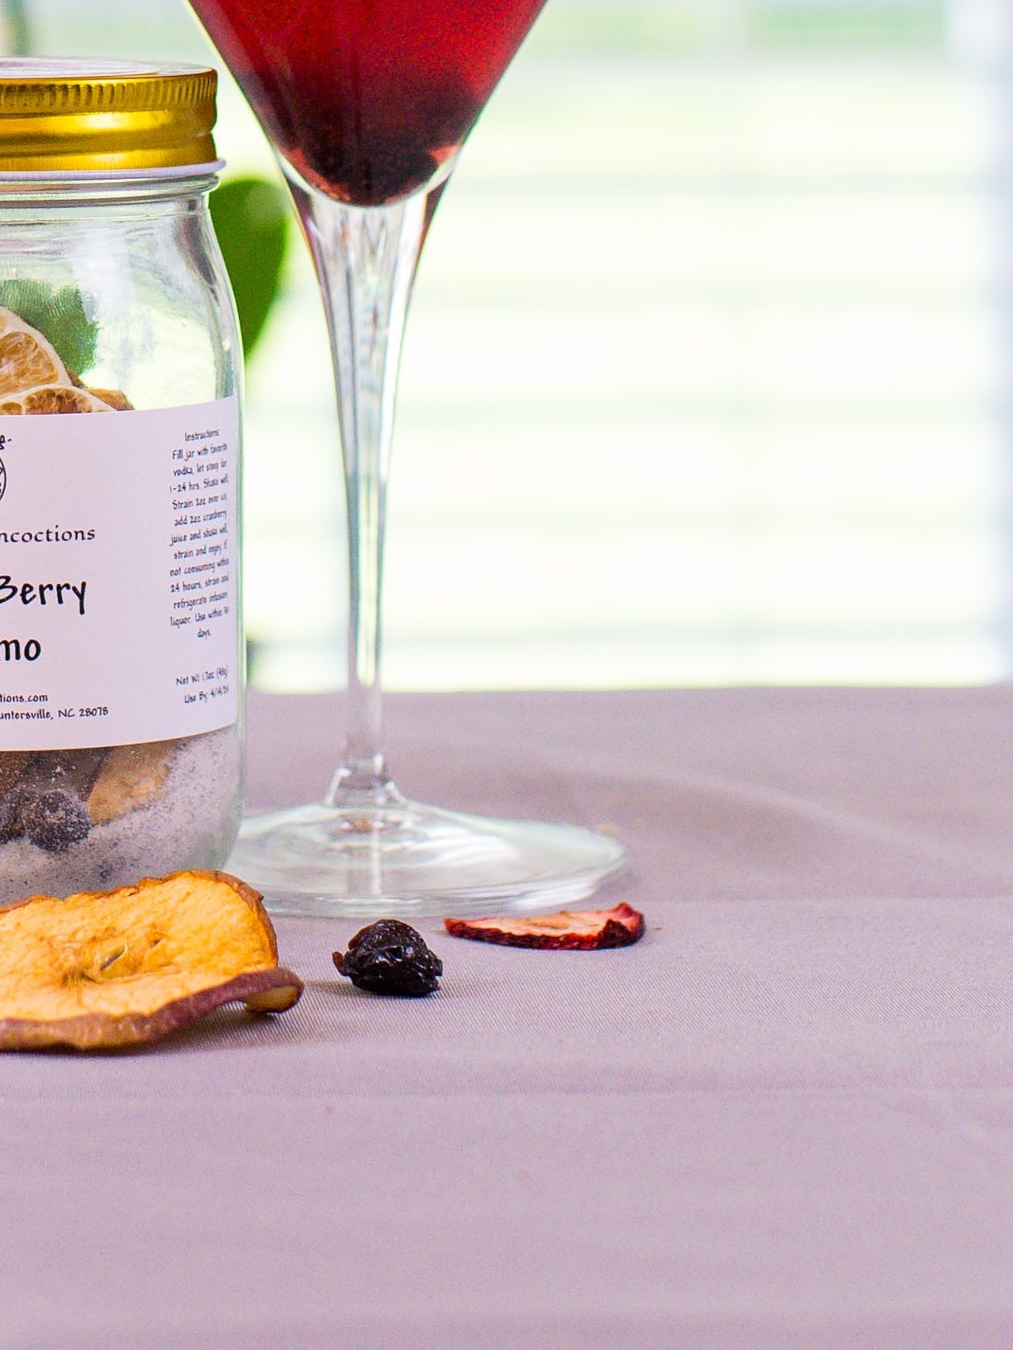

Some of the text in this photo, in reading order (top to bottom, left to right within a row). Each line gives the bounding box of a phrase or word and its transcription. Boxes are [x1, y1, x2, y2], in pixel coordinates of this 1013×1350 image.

[172, 449, 183, 460] Fill
[185, 450, 195, 461] jar
[196, 463, 204, 473] let
[172, 499, 194, 510] Strain
[174, 515, 187, 526] add
[190, 515, 201, 524] 2oz
[169, 534, 187, 547] juice
[190, 529, 201, 541] and
[174, 550, 194, 560] strain
[196, 545, 207, 556] and
[170, 566, 181, 577] not
[170, 582, 180, 593] 24
[195, 613, 206, 622] Use
[176, 676, 189, 685] Net
[185, 694, 196, 704] Use
[58, 709, 75, 719] NC
[79, 706, 109, 717] 28078
